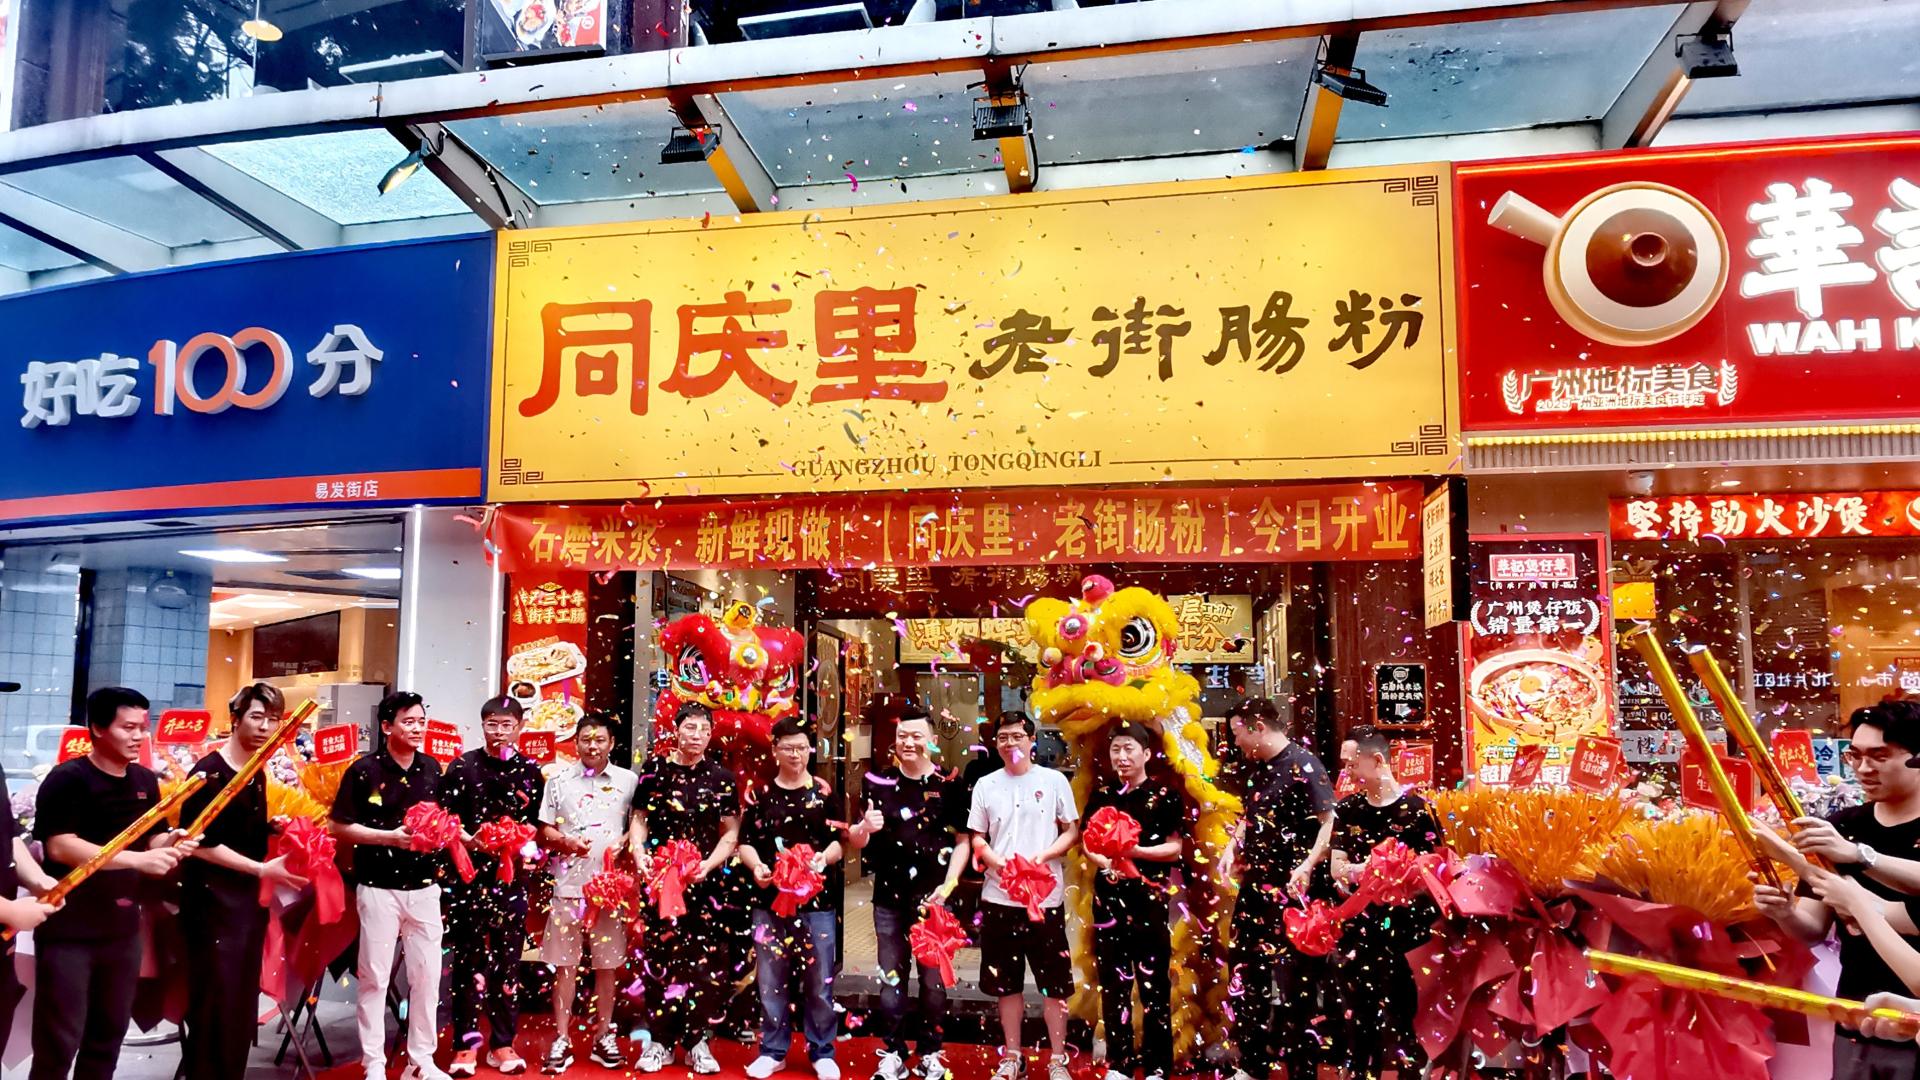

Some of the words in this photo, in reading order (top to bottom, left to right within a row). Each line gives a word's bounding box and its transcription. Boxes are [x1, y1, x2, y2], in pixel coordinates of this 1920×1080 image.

[1747, 319, 1883, 356] WAH
[518, 286, 949, 418] 同庆里
[21, 324, 384, 428] 好吃100分
[1521, 361, 1718, 400] 广州地标美食
[792, 456, 936, 477] GUANGZHOU
[949, 451, 1101, 473] TONGQINGLI
[315, 480, 379, 499] 易发街店
[1203, 613, 1232, 624] SOFT
[1486, 600, 1586, 617] 广州煲仔饭
[1486, 615, 1585, 635] 销量第一
